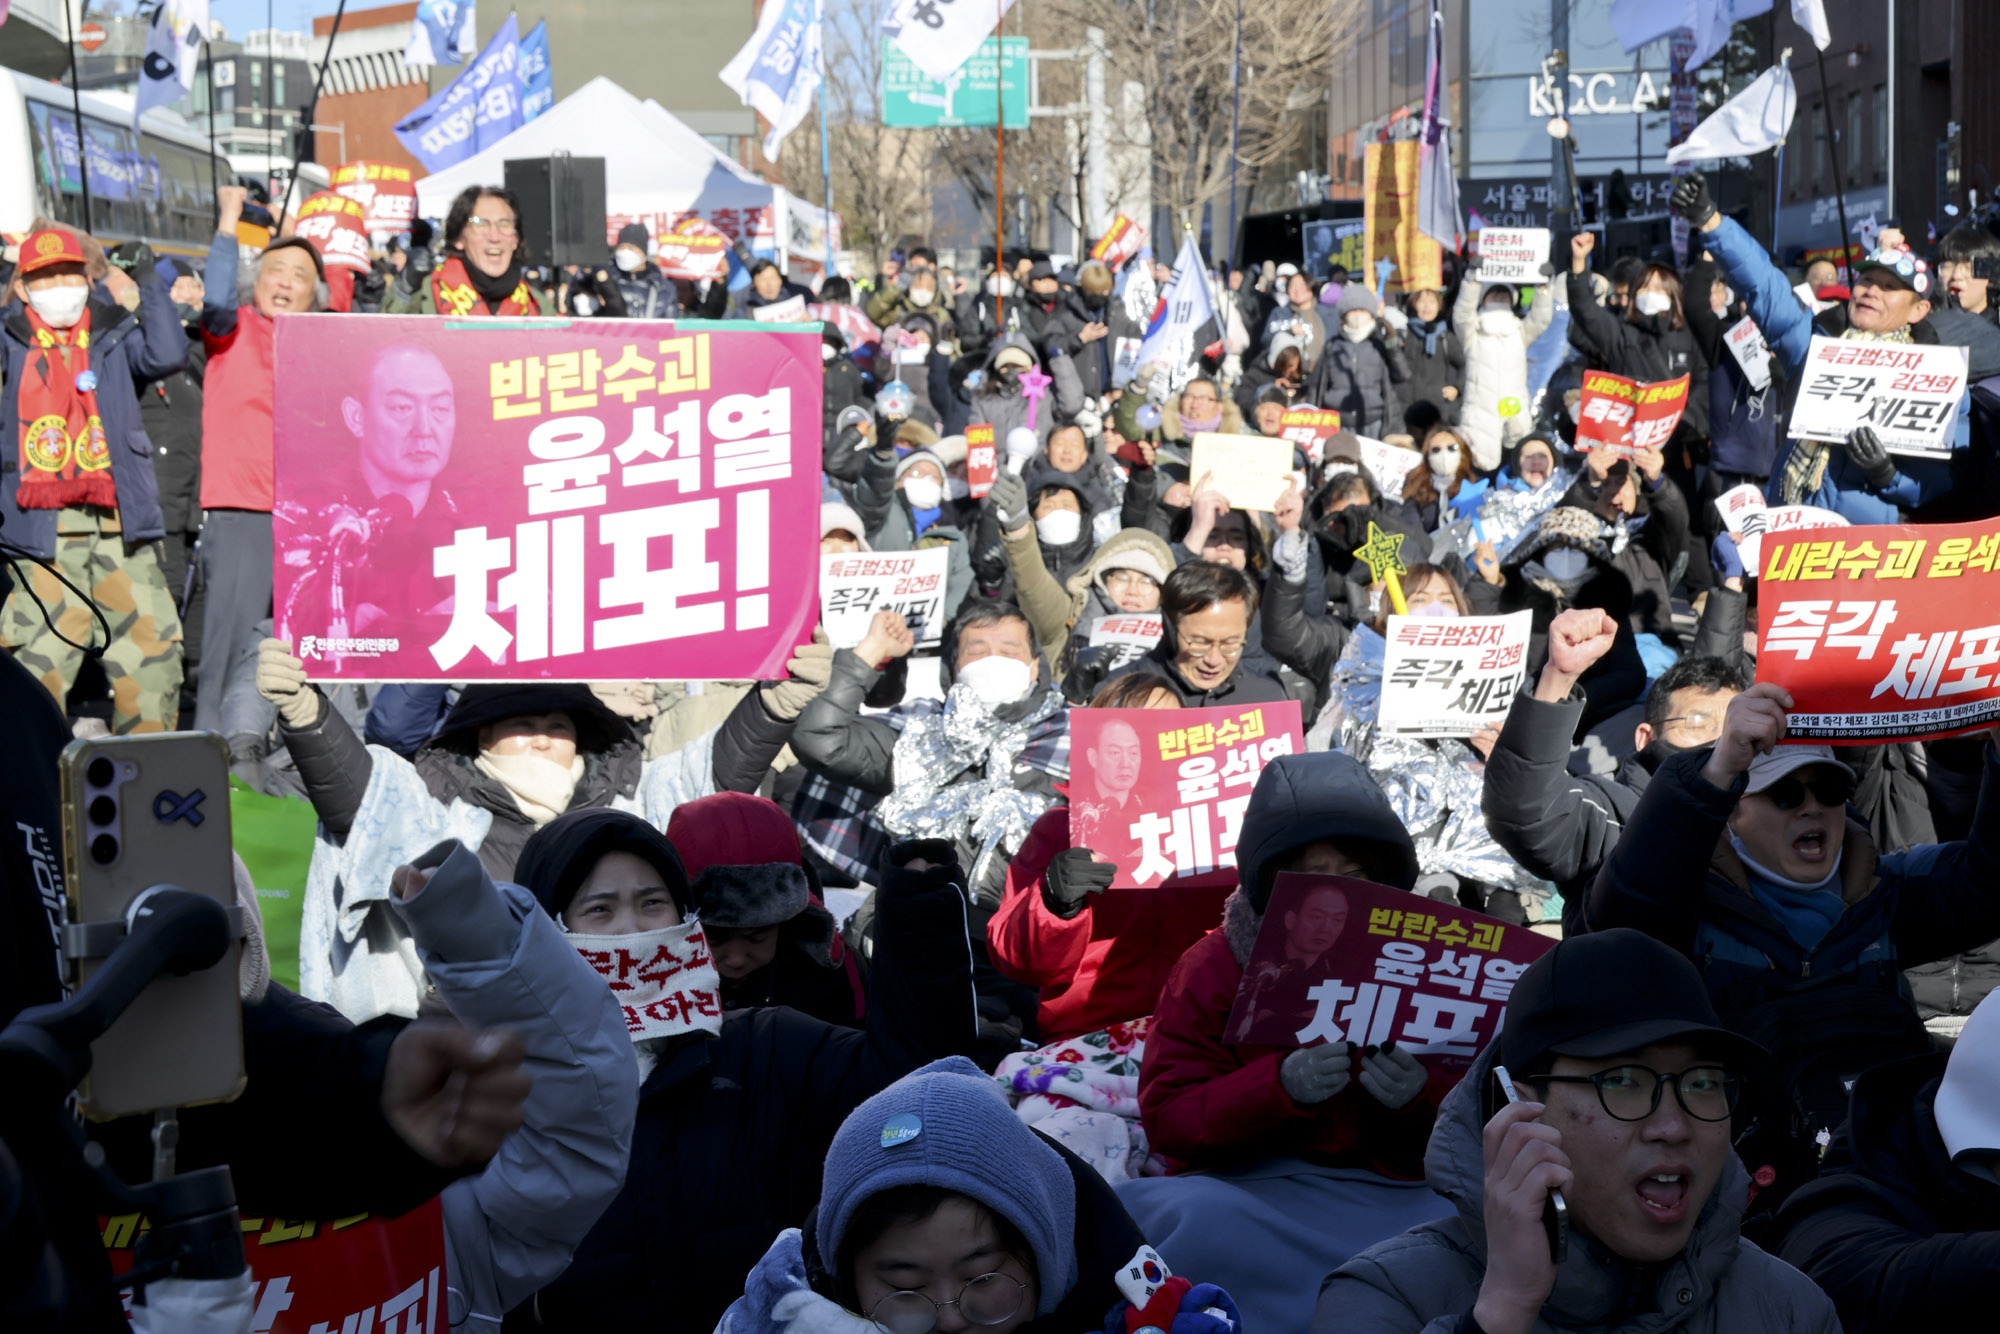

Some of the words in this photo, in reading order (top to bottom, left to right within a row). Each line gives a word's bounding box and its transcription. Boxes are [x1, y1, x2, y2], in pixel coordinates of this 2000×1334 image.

[1817, 345, 1924, 371] 특급범죄자
[489, 332, 711, 421] 반란수괴
[1806, 373, 1877, 404] 즉각
[1890, 371, 1960, 394] 김건희
[1583, 397, 1634, 427] 즉각
[1856, 396, 1955, 434] 체포!
[523, 386, 793, 516] 윤석열
[828, 559, 916, 578] 특급범죄자
[1764, 539, 1927, 581] 내란수괴
[1927, 531, 2000, 579] 윤석
[428, 488, 769, 672] 체포!
[893, 574, 941, 595] 김건희
[828, 587, 880, 615] 즉각
[1100, 619, 1163, 637] 특급범
[1396, 624, 1505, 646] 특급범죄자
[1764, 600, 1898, 660] 즉각
[1478, 643, 1524, 669] 김건희
[1870, 624, 2000, 700] 체포
[1389, 658, 1464, 690] 즉각
[1790, 715, 1820, 726] 윤석열
[1822, 715, 1842, 726] 즉각
[1844, 715, 1868, 726] 체포!
[1871, 714, 1899, 725] 김건희
[1901, 712, 1919, 724] 즉각
[1921, 711, 1942, 721] 구속!
[1158, 708, 1265, 761] 반란수괴
[1367, 907, 1505, 953] 반란수괴
